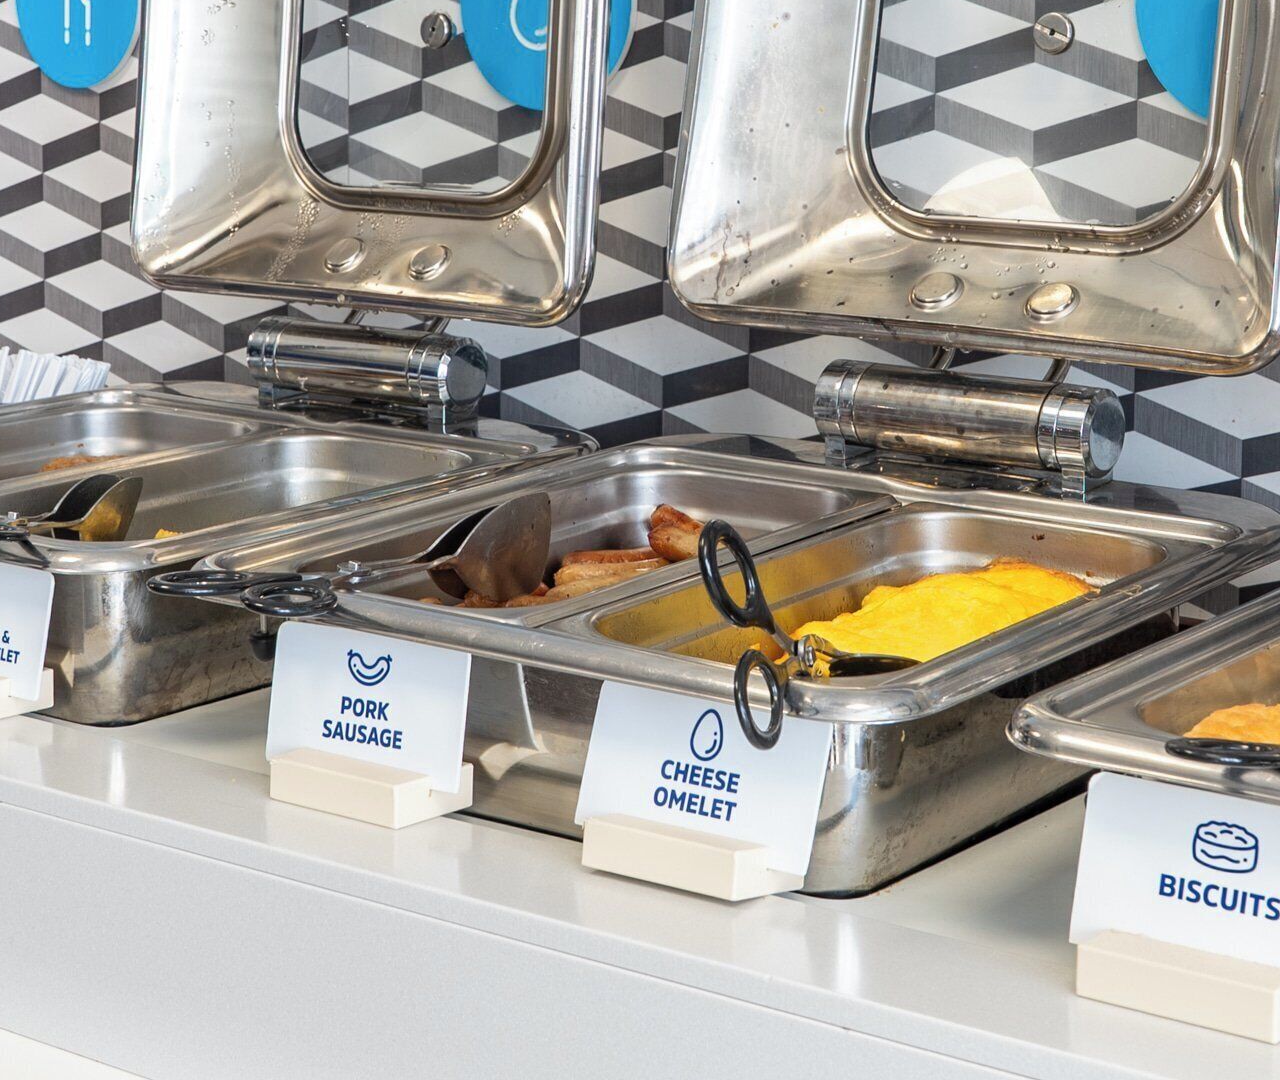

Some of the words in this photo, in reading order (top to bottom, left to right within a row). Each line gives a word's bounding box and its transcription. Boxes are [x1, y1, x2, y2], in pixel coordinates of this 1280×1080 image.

[1, 630, 11, 644] &
[340, 696, 390, 721] PORK
[322, 719, 403, 750] SAUSAGE
[660, 759, 741, 794] CHEESE
[653, 786, 738, 822] OMELET
